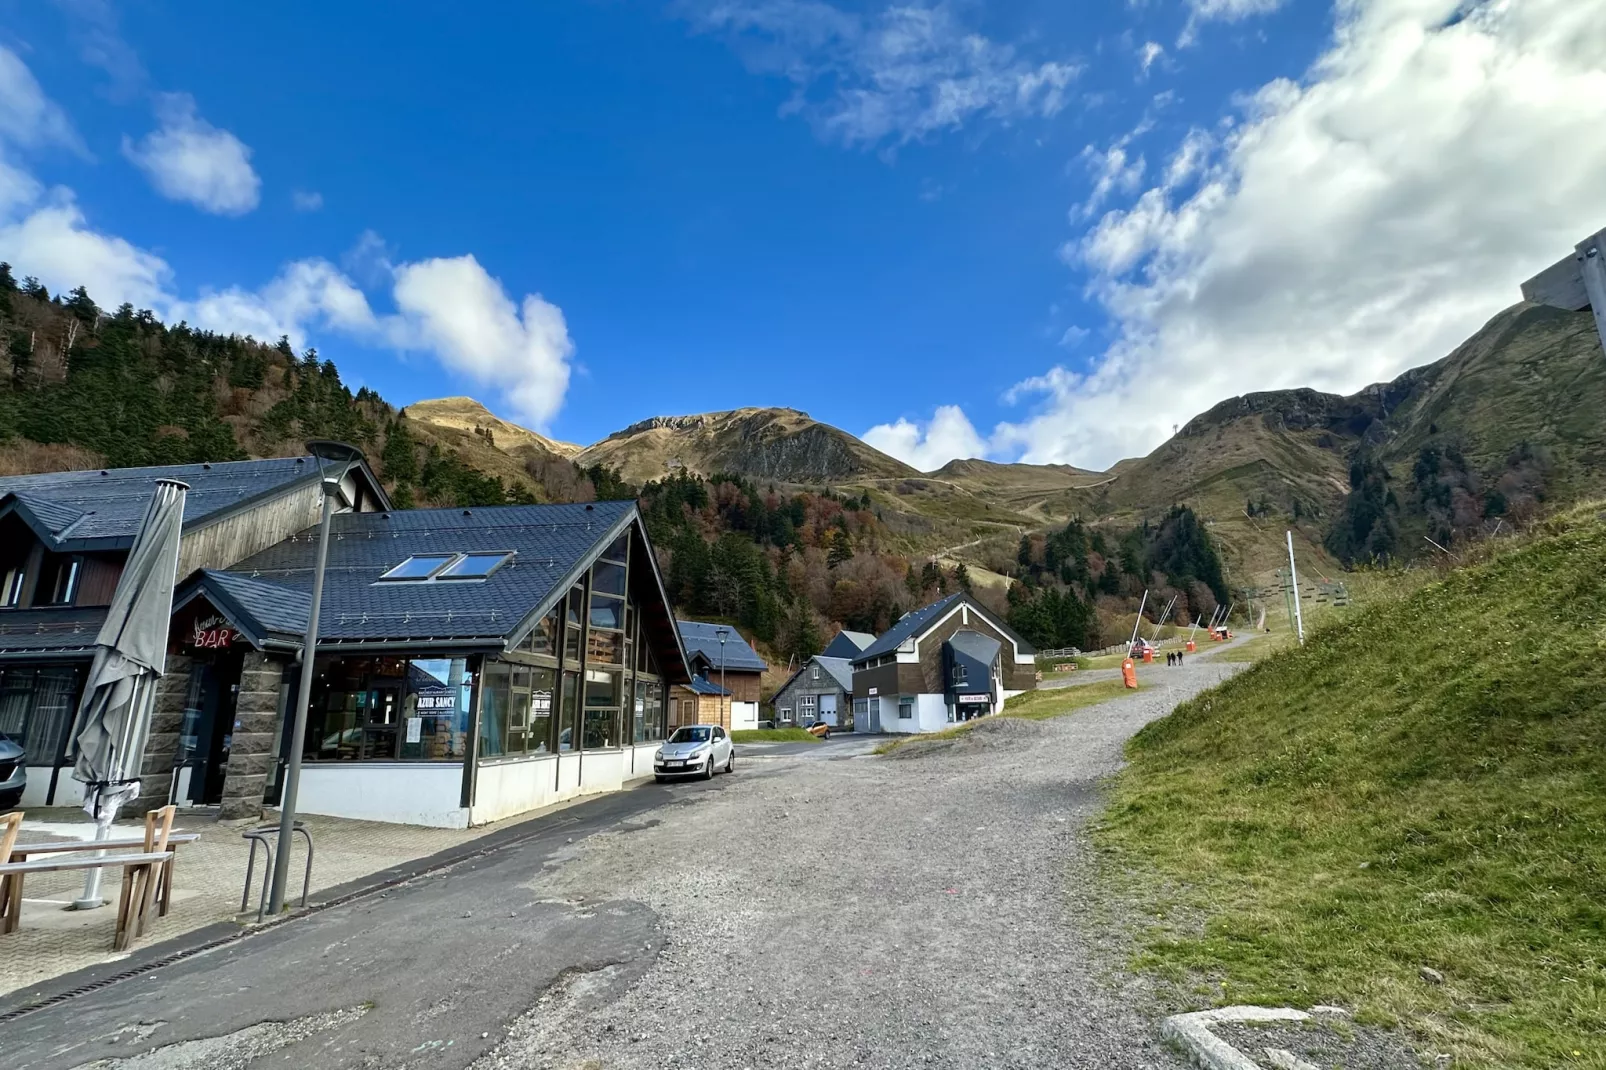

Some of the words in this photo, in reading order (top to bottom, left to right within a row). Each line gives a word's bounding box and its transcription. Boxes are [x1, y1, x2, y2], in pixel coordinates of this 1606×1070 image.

[194, 629, 229, 647] BAR
[417, 697, 435, 708] AZUR
[435, 697, 456, 708] SANCY
